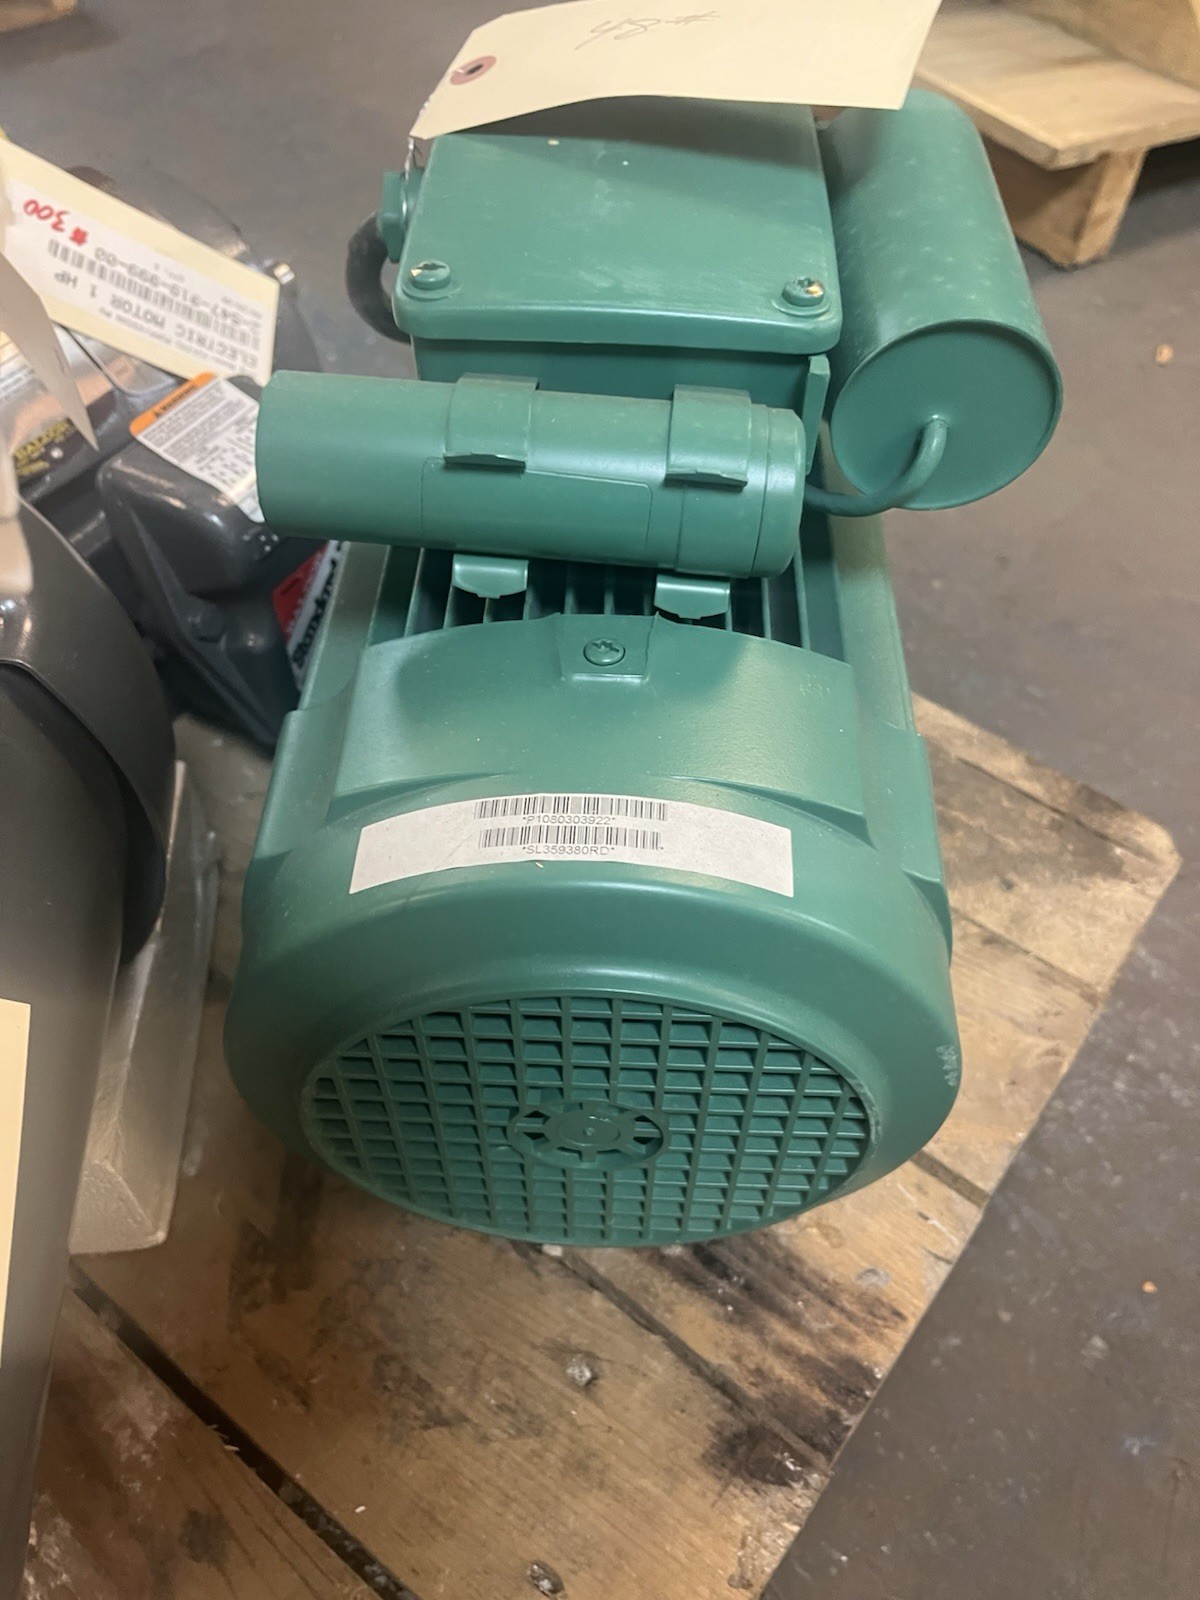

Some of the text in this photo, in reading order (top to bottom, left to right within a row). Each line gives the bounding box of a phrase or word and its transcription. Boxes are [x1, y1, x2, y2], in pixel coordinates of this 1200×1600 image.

[53, 270, 79, 289] HP
[109, 294, 166, 329] MOTOR
[174, 323, 258, 368] ELECTRIC
